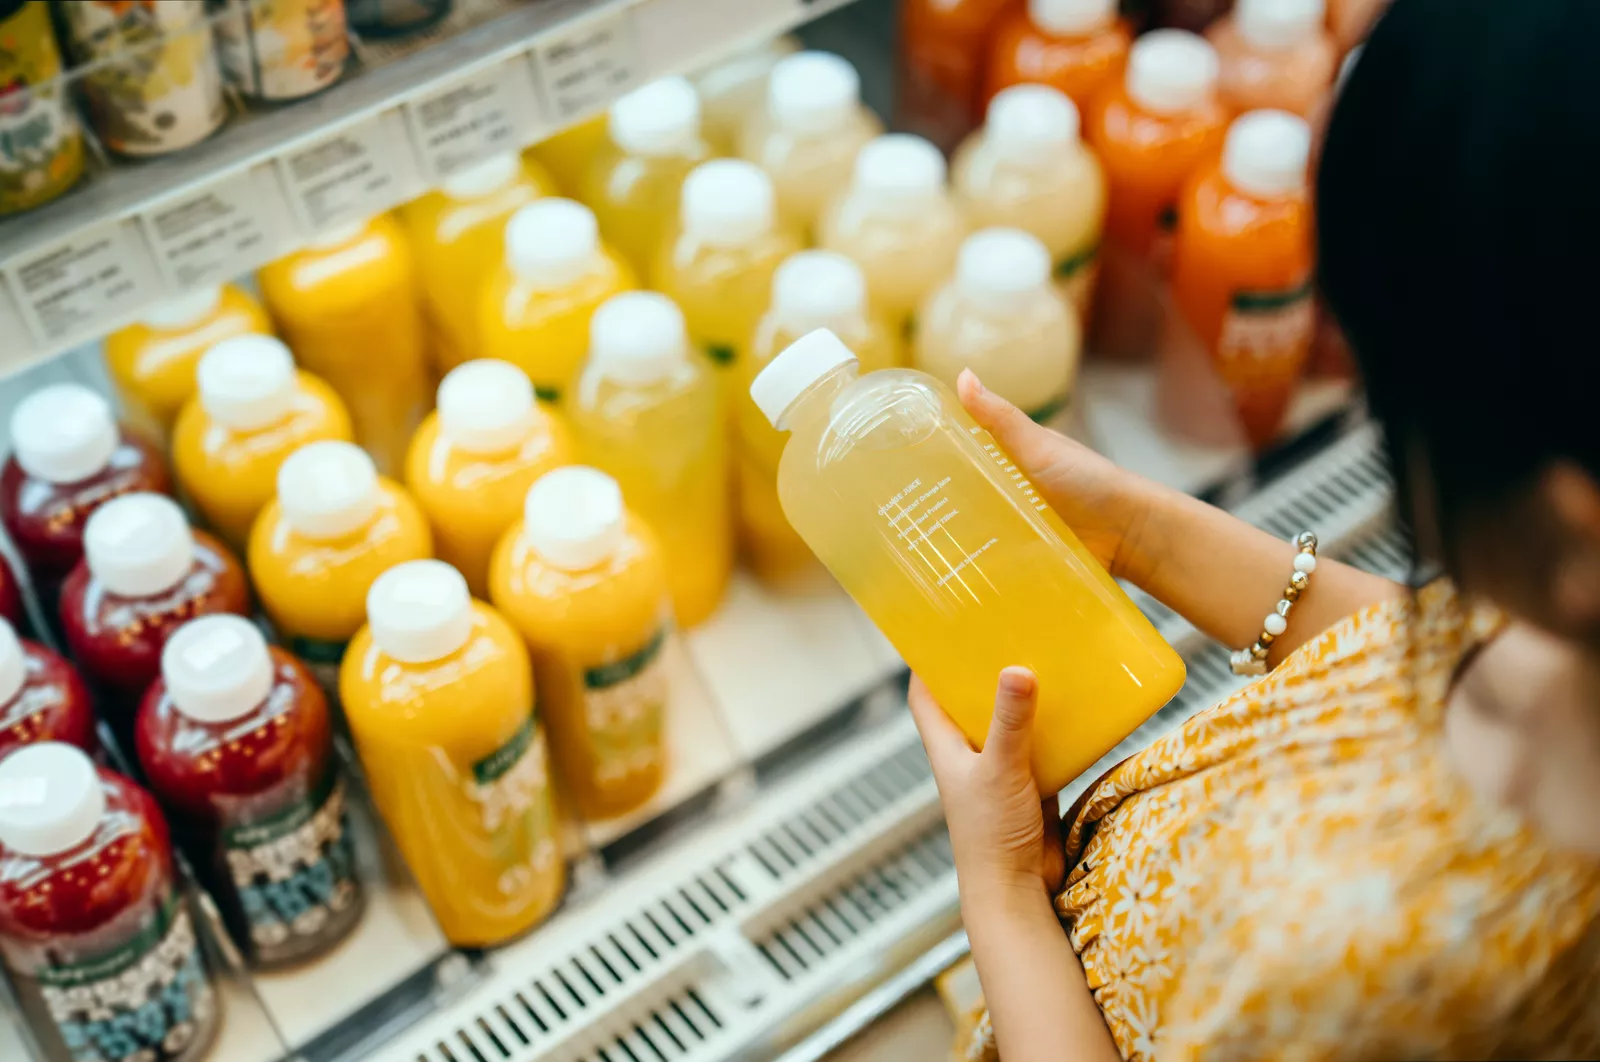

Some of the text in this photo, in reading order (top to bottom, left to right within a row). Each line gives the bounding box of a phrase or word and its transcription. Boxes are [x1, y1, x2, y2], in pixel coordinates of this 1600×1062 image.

[878, 477, 921, 516] ORANGE JUICE
[920, 486, 938, 501] Orange
[928, 497, 948, 514] Product
